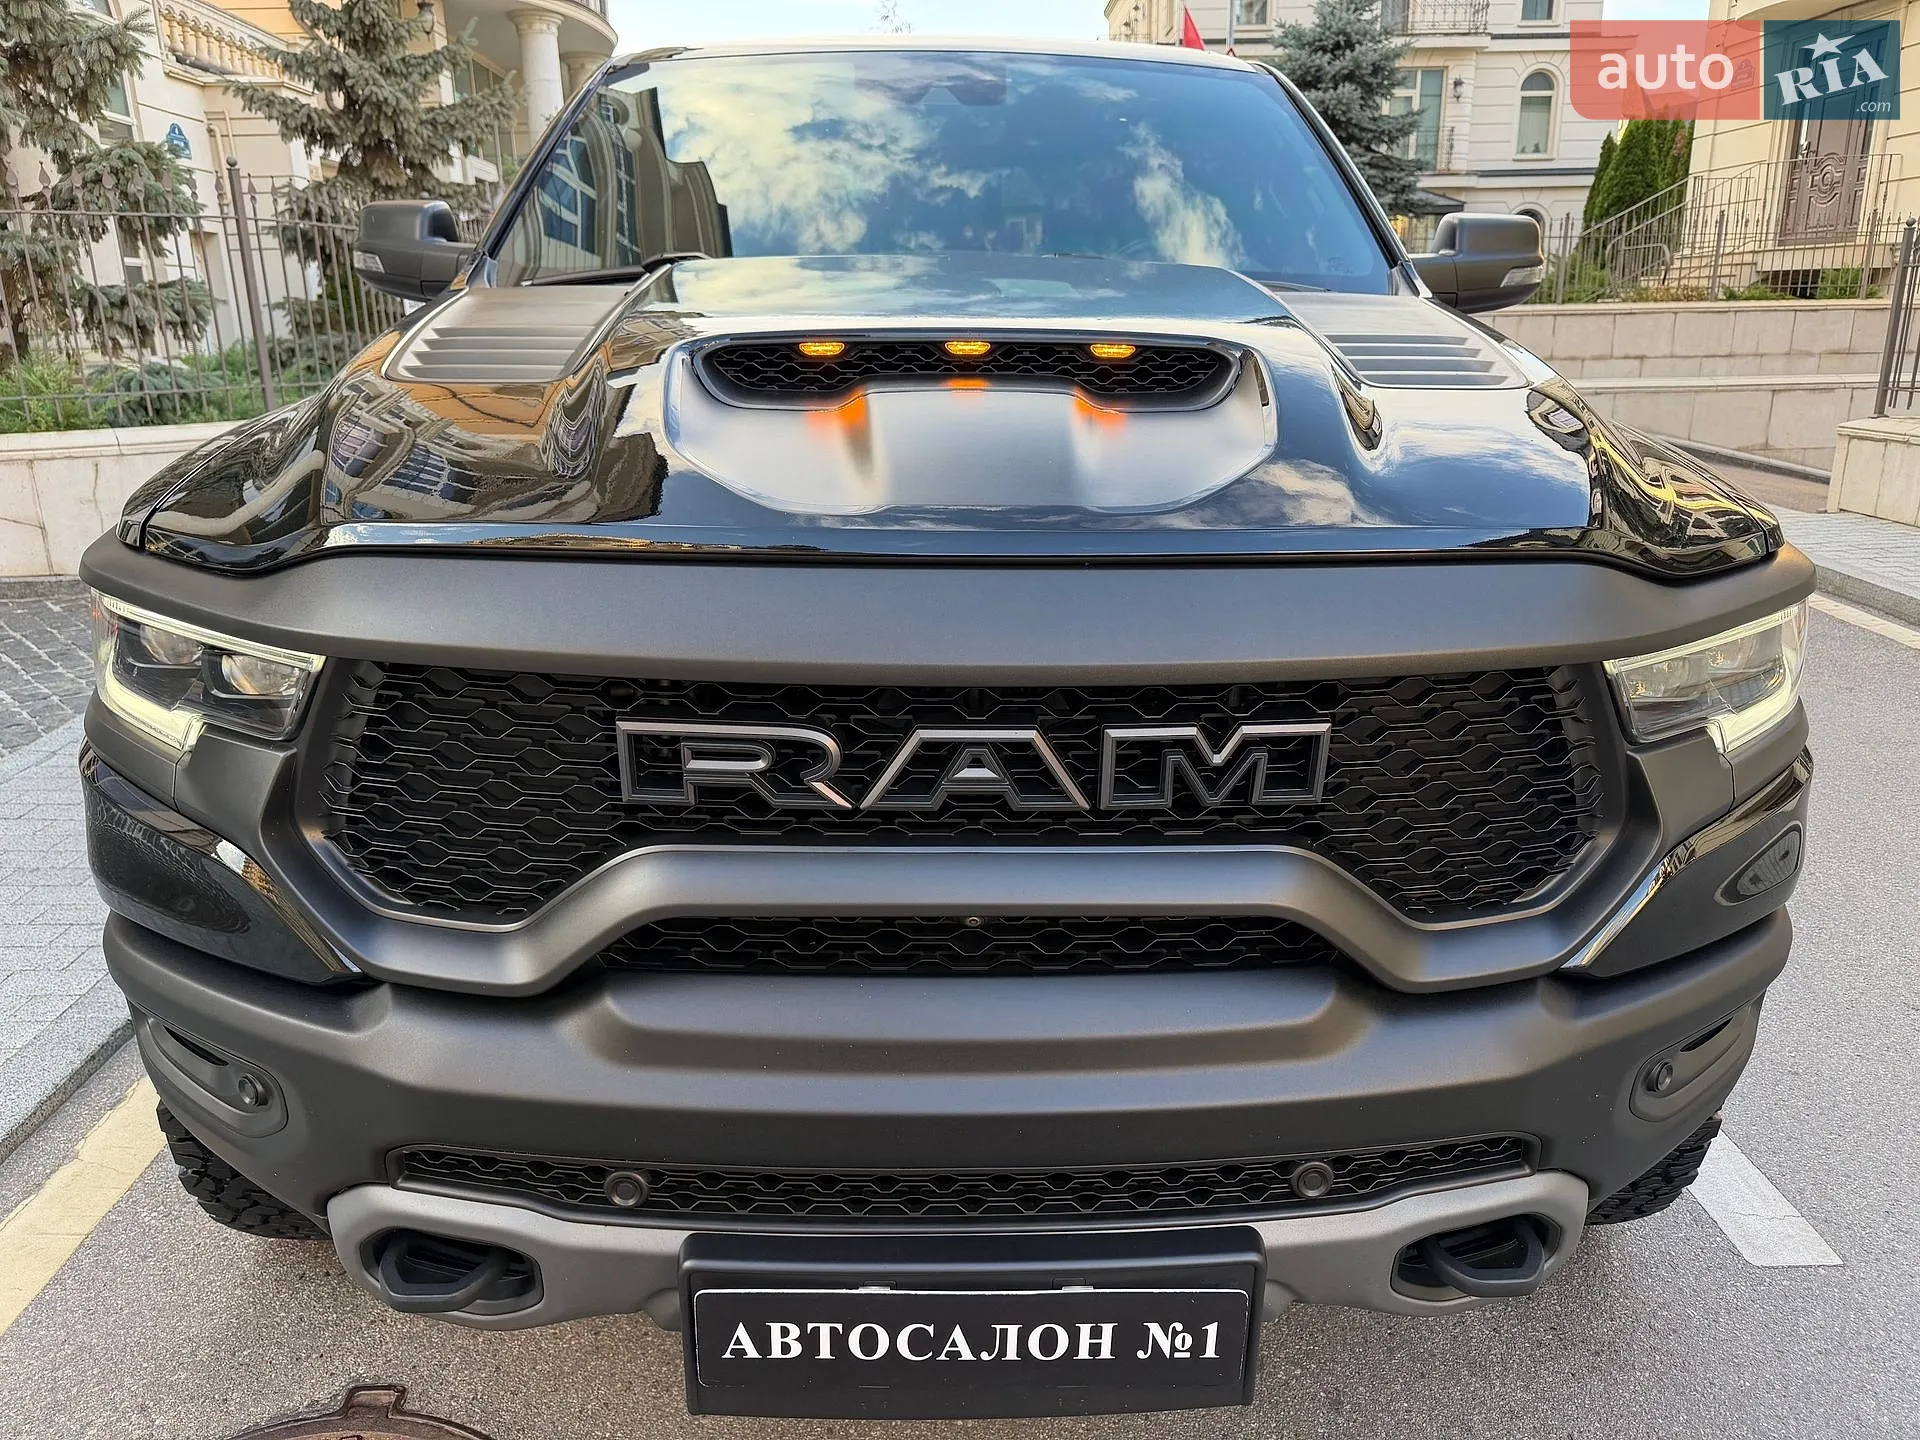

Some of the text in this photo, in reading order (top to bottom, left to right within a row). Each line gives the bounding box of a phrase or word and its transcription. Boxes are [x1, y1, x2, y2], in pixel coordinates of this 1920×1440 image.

[615, 717, 1333, 811] RAM
[721, 1321, 1221, 1361] АВТОСАЛОН №1
